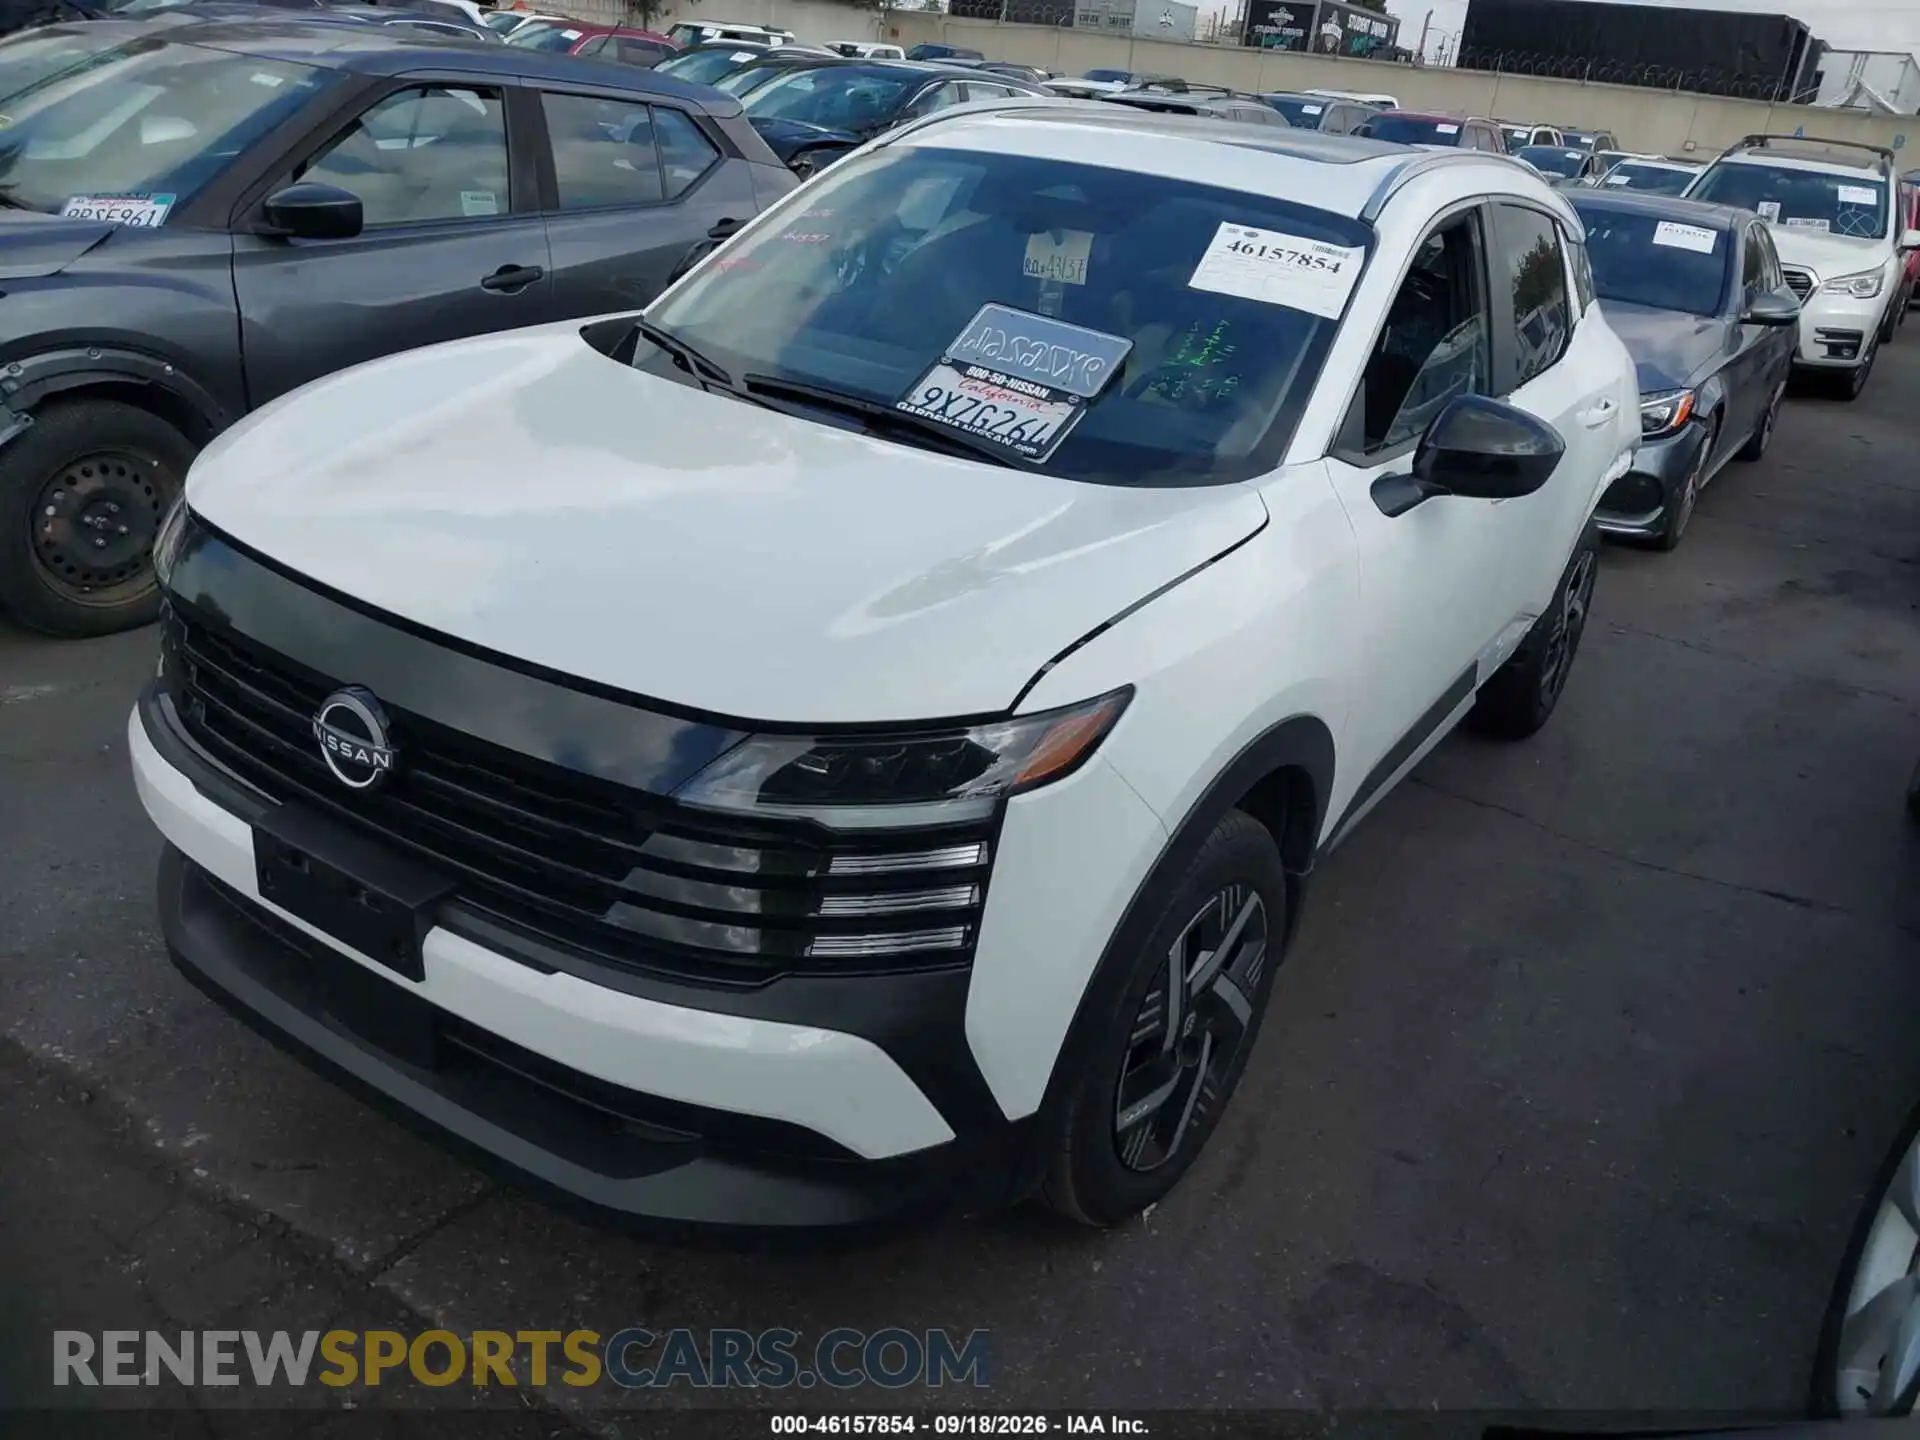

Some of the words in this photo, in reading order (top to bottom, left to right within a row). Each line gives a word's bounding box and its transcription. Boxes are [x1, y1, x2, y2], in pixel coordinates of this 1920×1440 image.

[1226, 240, 1342, 274] 46157854
[957, 377, 1045, 414] California
[965, 366, 1051, 400] 800-50-NISSAN
[312, 721, 390, 768] NISSAN
